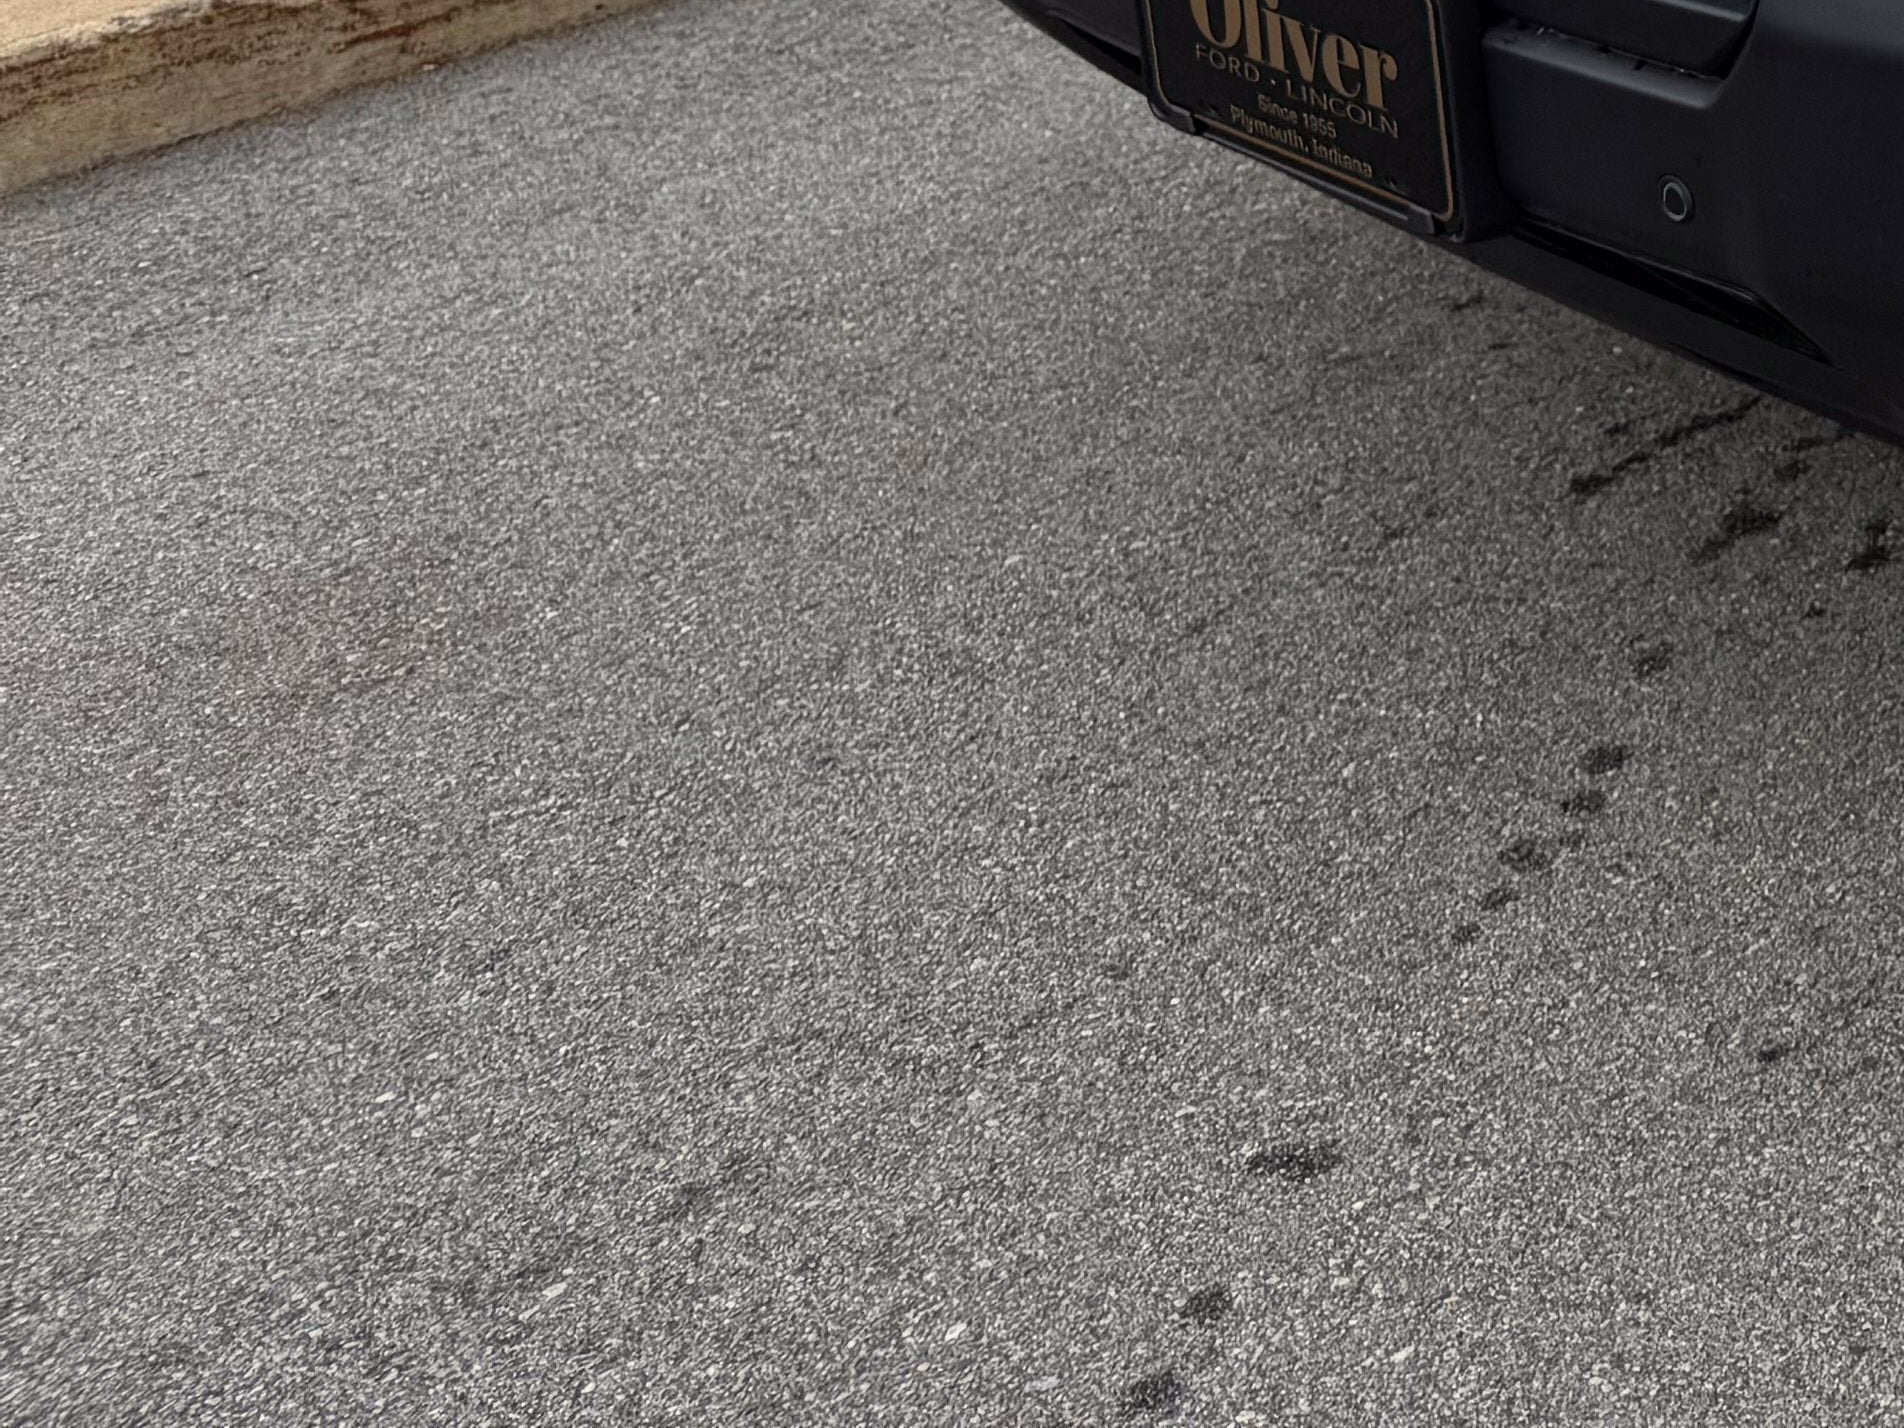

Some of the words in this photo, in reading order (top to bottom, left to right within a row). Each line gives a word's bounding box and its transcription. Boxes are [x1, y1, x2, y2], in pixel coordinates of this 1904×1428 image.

[1195, 43, 1261, 84] FORD
[1286, 79, 1400, 139] LINCOLN
[1257, 92, 1298, 124] Since
[1230, 103, 1309, 153] Plymouth,
[1312, 137, 1374, 179] Indiana
